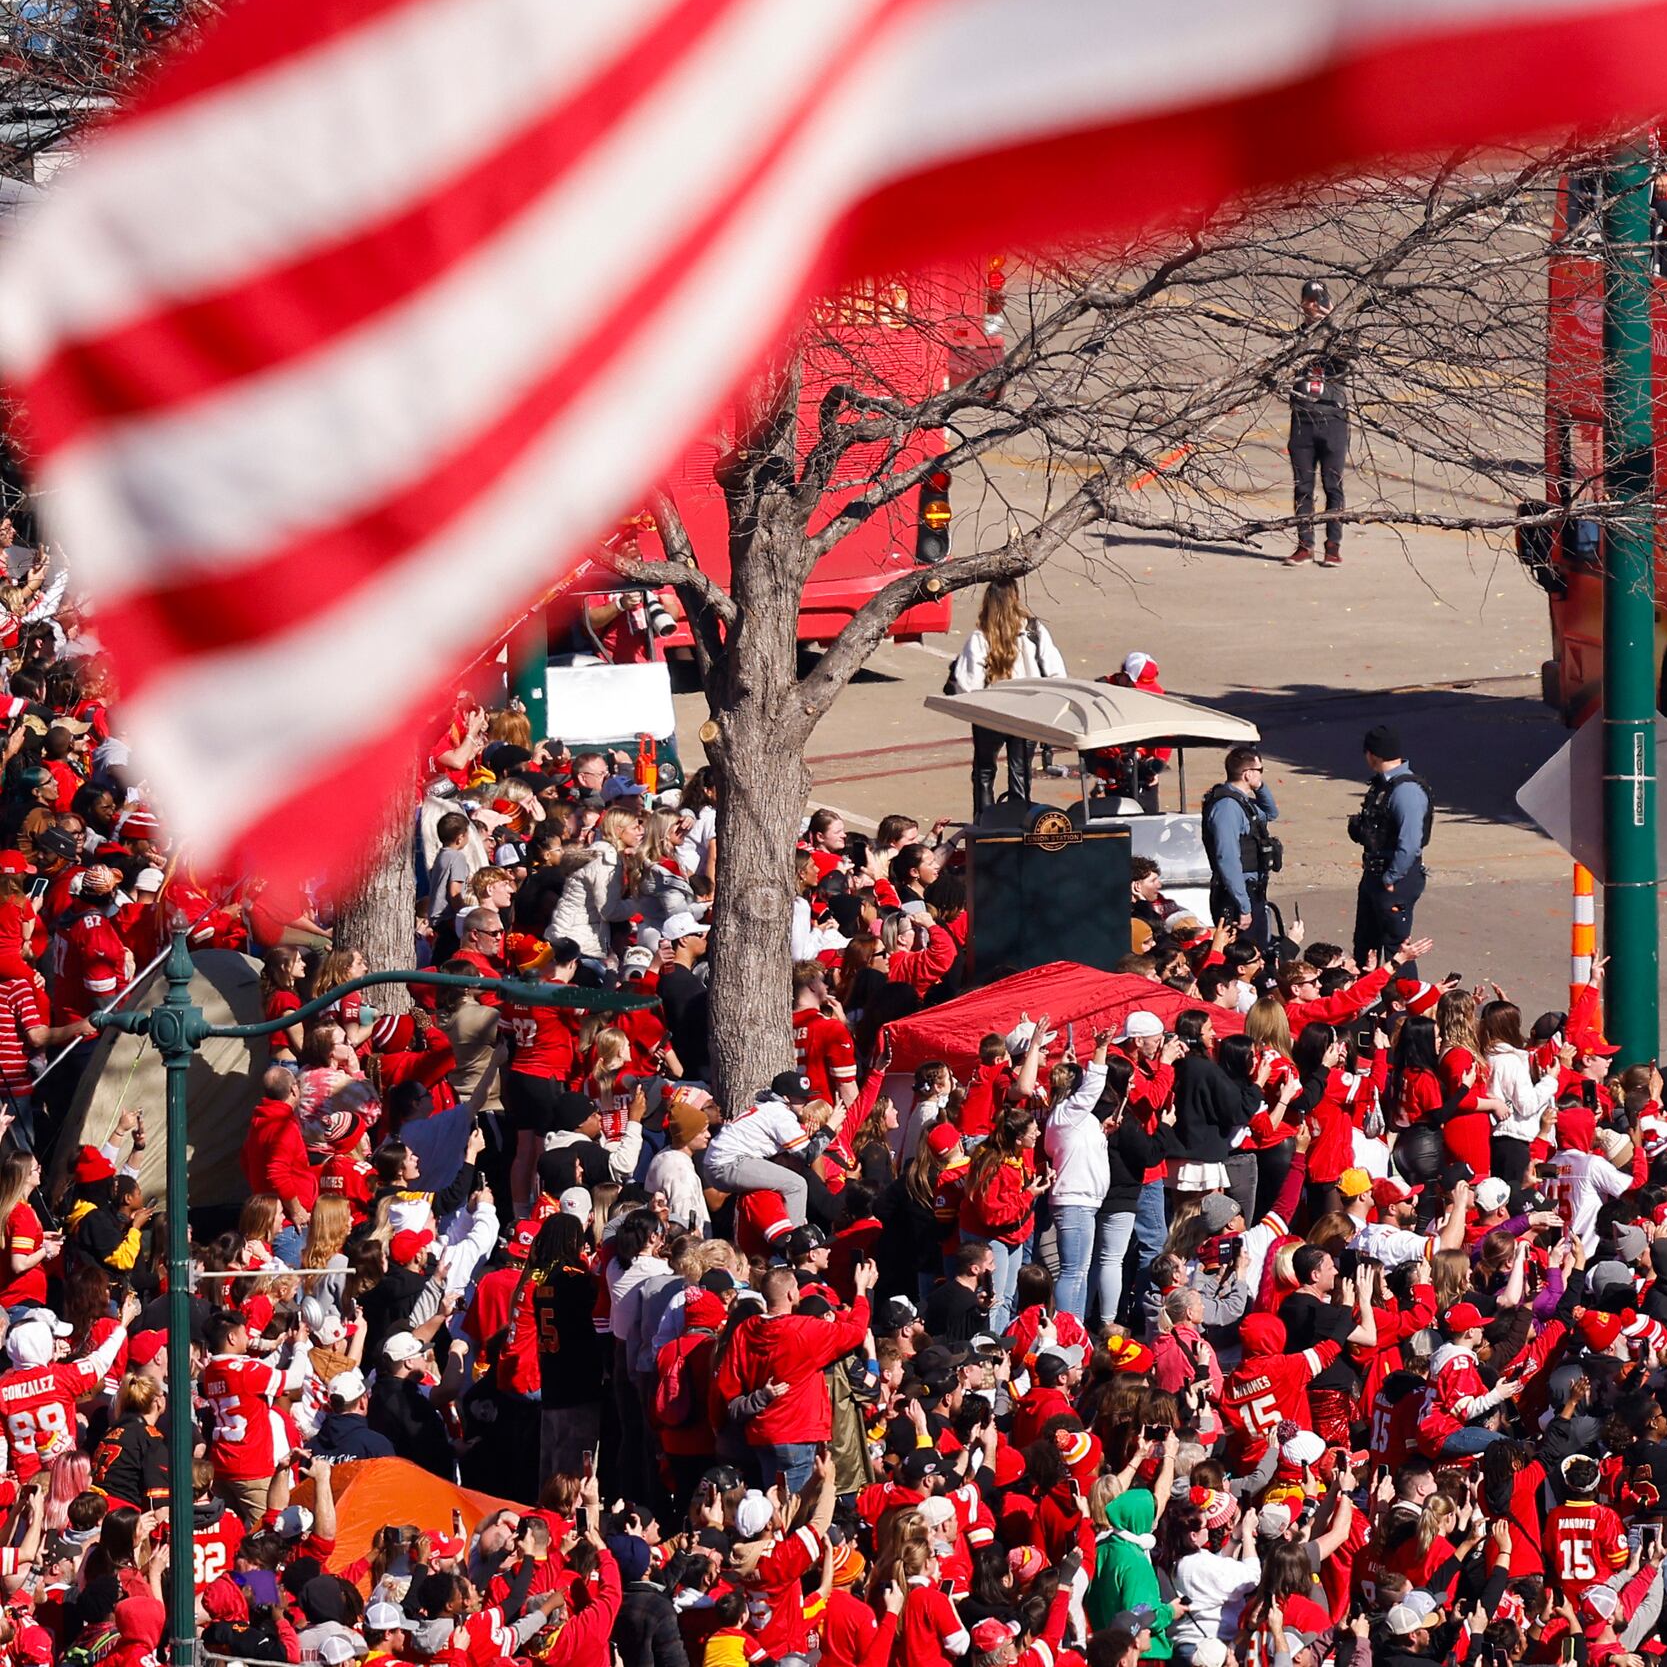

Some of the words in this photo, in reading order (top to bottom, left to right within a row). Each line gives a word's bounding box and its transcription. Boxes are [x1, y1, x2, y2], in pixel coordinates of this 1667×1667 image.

[83, 914, 102, 930] 87
[345, 1008, 360, 1019] 25
[1452, 1355, 1471, 1371] 15
[2, 1374, 56, 1401] GONZALEZ
[1232, 1375, 1272, 1400] MAHOMES
[1238, 1393, 1284, 1440] 15
[1371, 1406, 1392, 1453] 15
[1558, 1517, 1597, 1531] MAHOMES
[1559, 1538, 1598, 1581] 15
